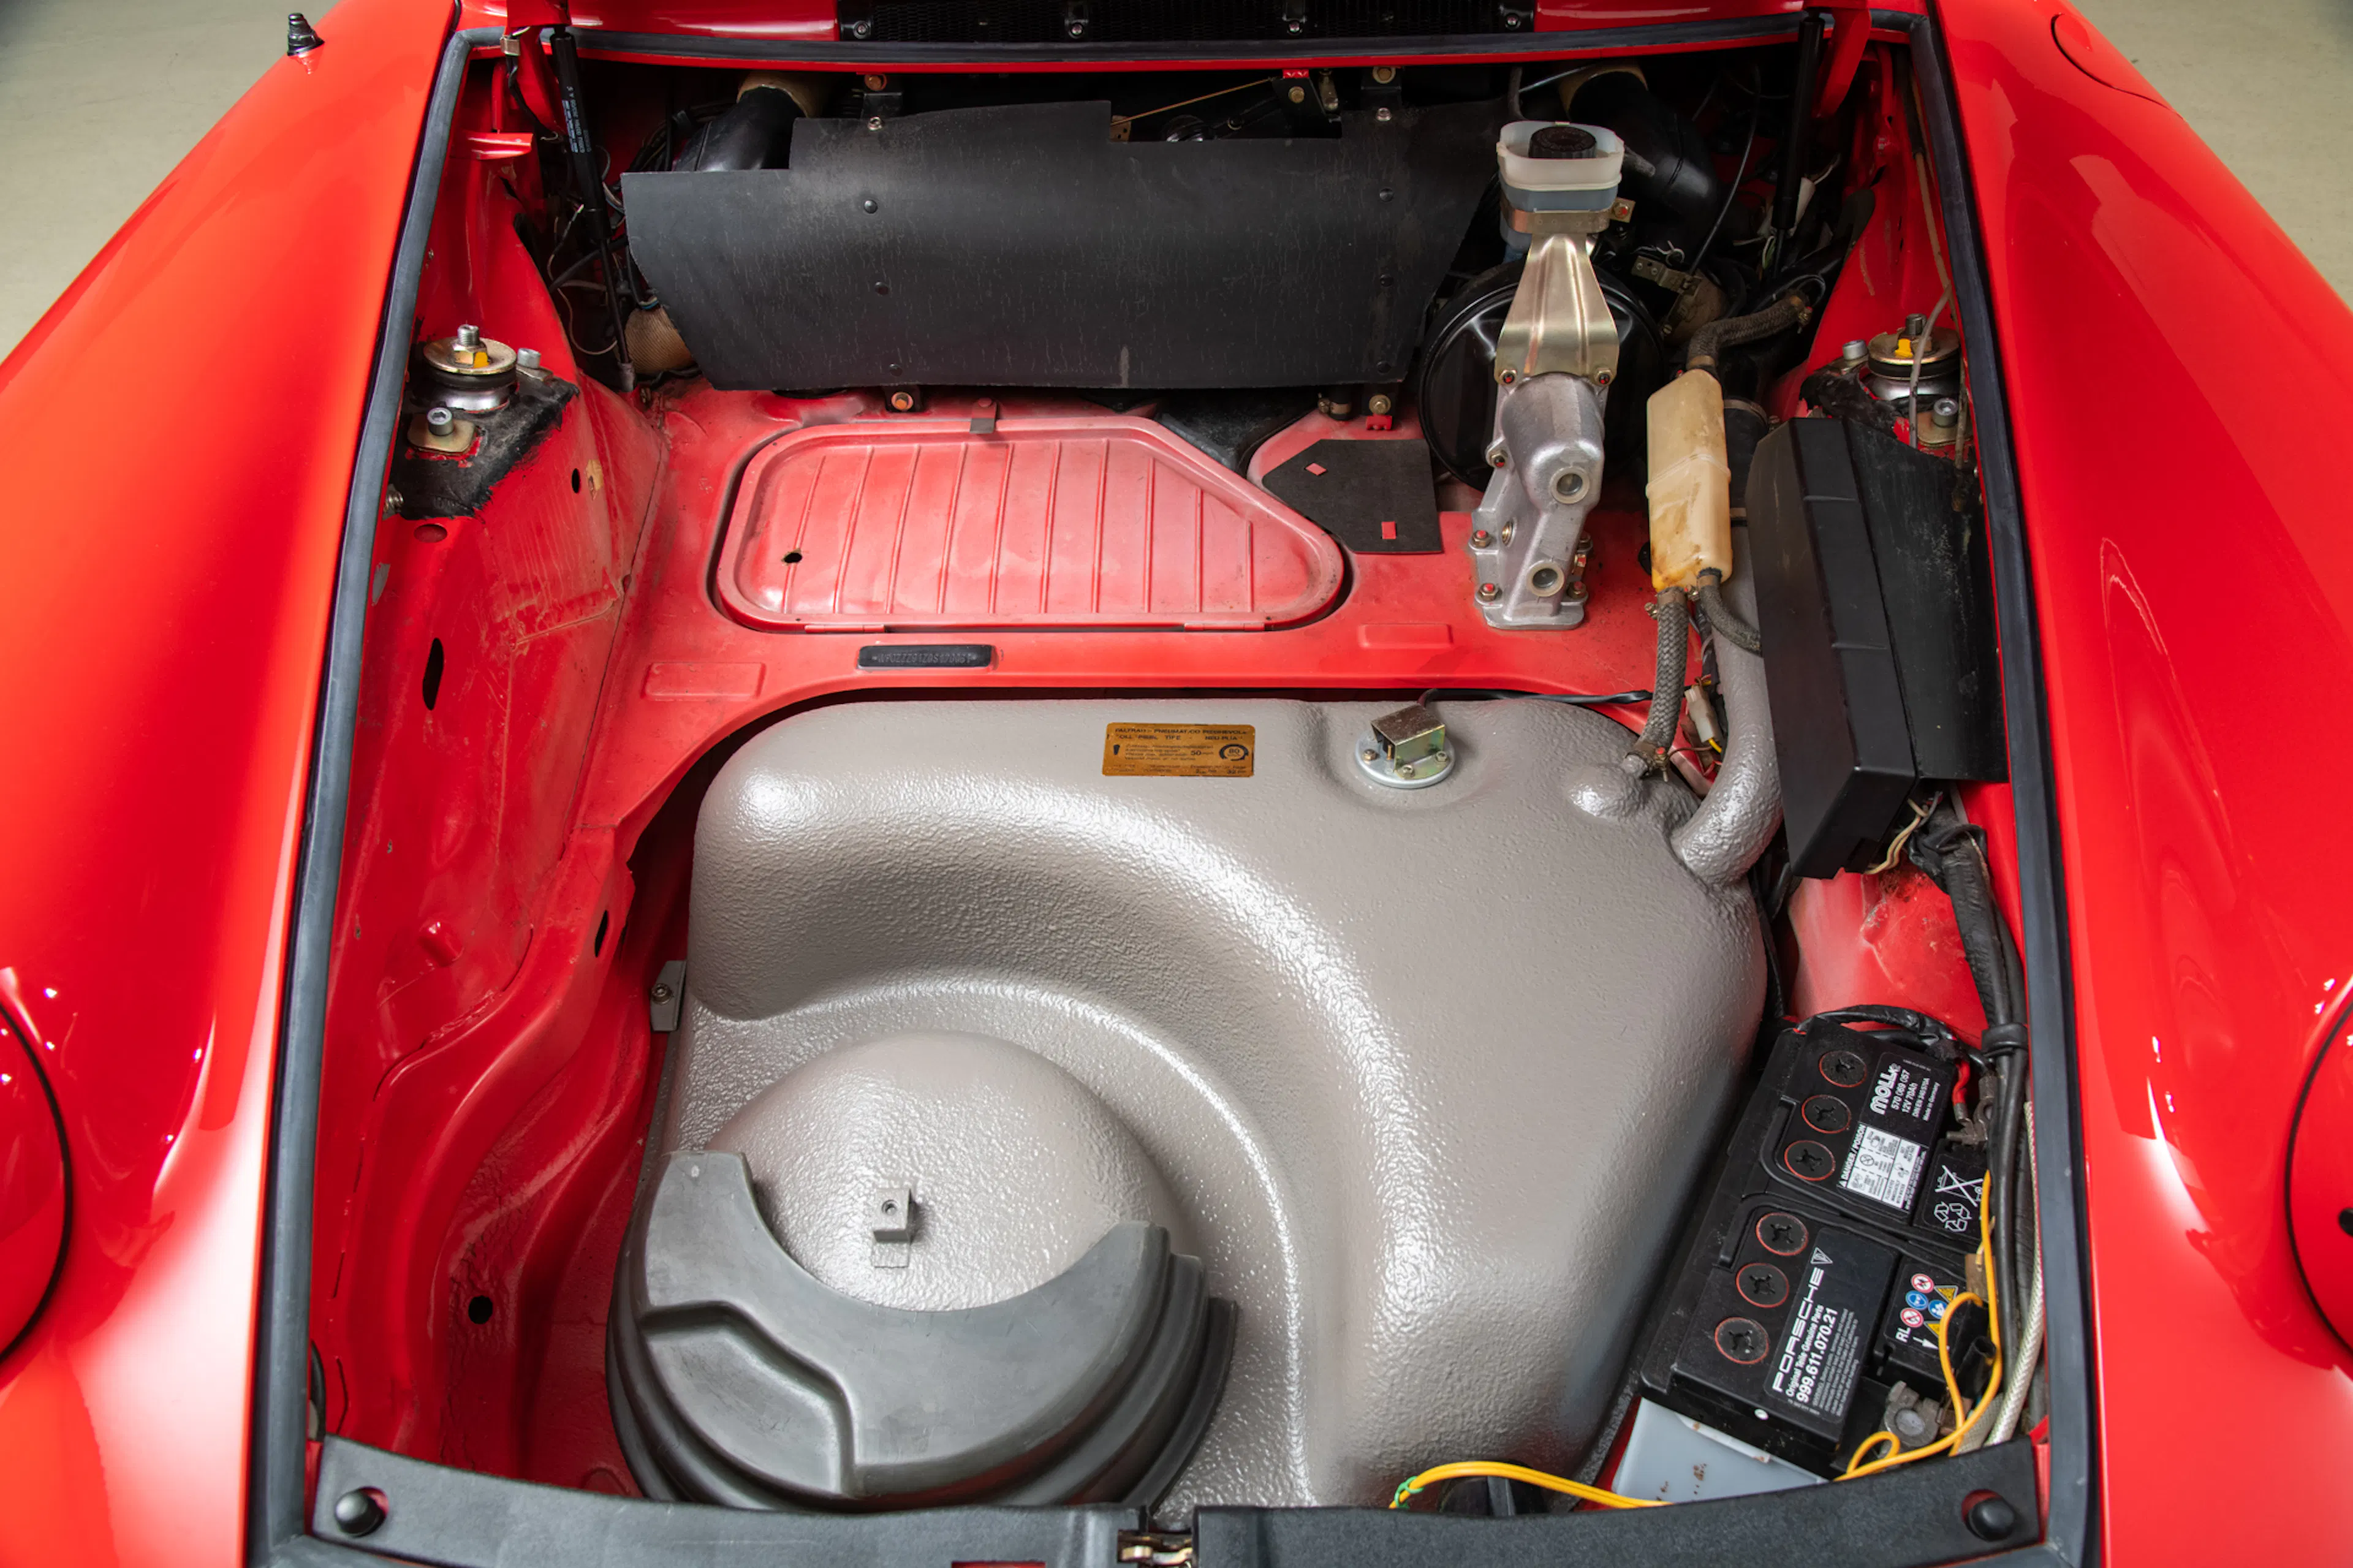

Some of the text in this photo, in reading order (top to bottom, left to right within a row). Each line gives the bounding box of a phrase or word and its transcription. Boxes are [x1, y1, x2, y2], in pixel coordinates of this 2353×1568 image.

[1895, 1081, 1906, 1097] 069
[1890, 1095, 1902, 1110] 570
[1901, 1099, 1912, 1113] 12V
[1771, 1267, 1824, 1392] PORSCHE
[1895, 1327, 1911, 1343] RL
[1785, 1367, 1802, 1398] Original
[1802, 1322, 1818, 1352] Genuine
[1811, 1303, 1824, 1324] Parts
[1795, 1307, 1838, 1403] 999.611.070.21
